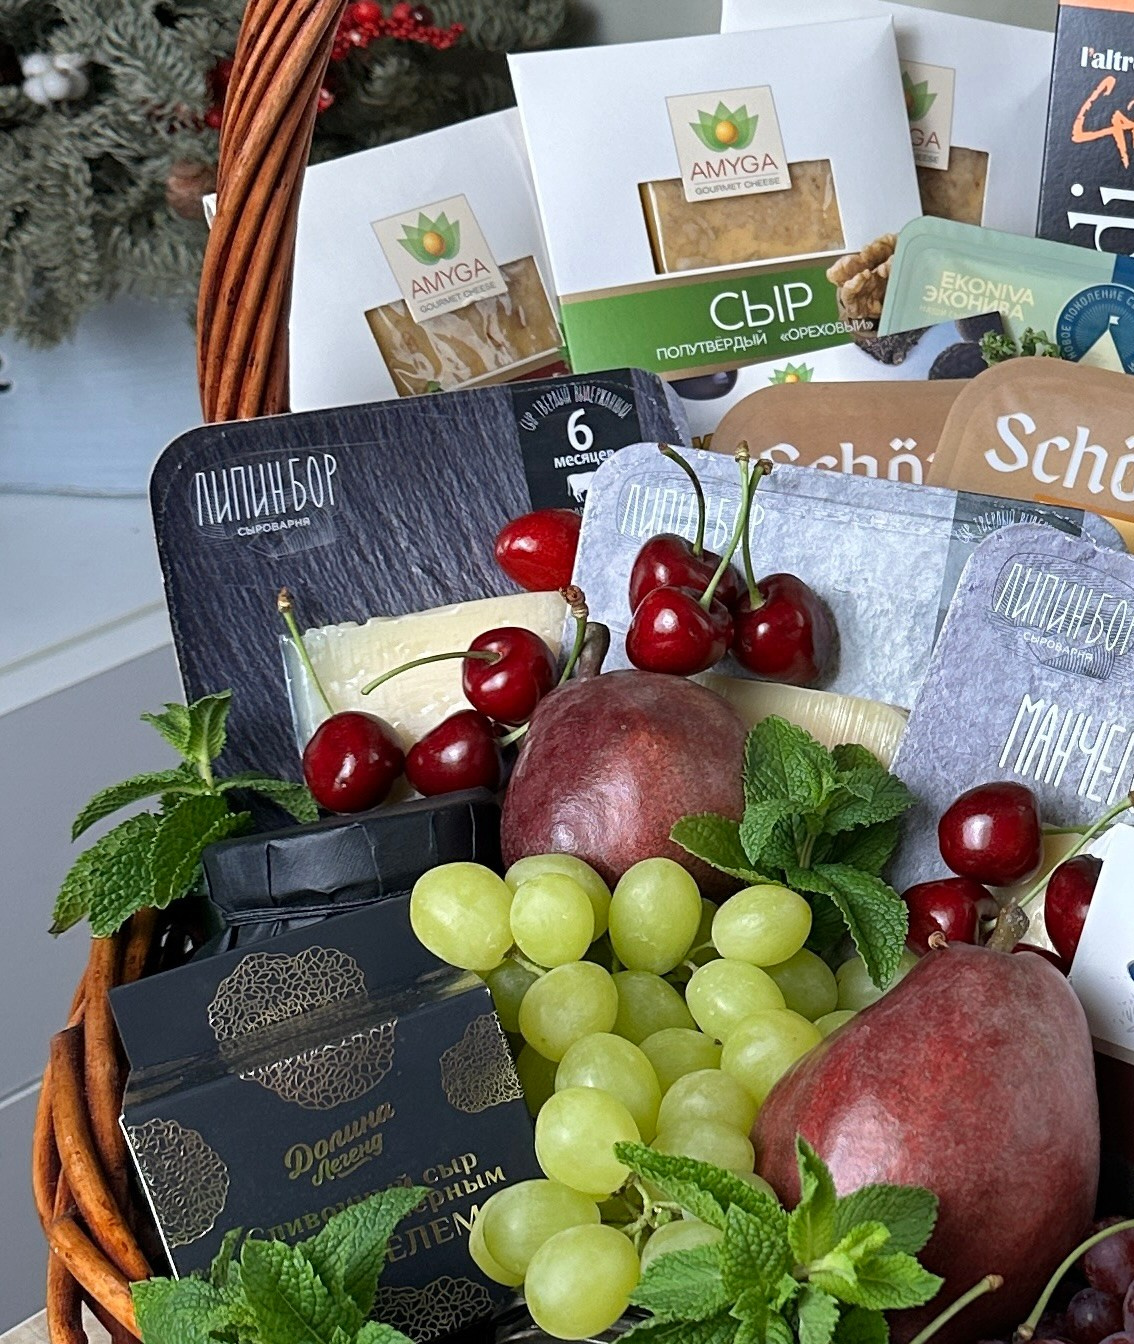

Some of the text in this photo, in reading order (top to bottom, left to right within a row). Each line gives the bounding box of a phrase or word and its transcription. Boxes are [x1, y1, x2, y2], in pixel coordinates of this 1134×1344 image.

[691, 153, 778, 181] AMYGA
[695, 177, 780, 195] GOURMET CHEESE
[412, 258, 490, 298] AMYGA
[941, 271, 1034, 306] EKONIVA
[419, 281, 496, 313] GOURMET CHEESE
[709, 282, 813, 331] СЫР
[922, 285, 1023, 321] ЭКОНИВА
[1064, 289, 1125, 322] ПОКОЛЕНИЕ
[656, 330, 767, 361] ПОЛУТВЁРДЫЙ
[567, 408, 594, 451] 6
[195, 454, 337, 526] ЛИПИН БОР
[237, 517, 311, 536] СЫРОВАРНЯ
[995, 563, 1093, 639] ЛИПИН
[1024, 631, 1093, 661] СЫРОВАРНЯ
[284, 1102, 395, 1180] Долина
[422, 1152, 478, 1184] сыр
